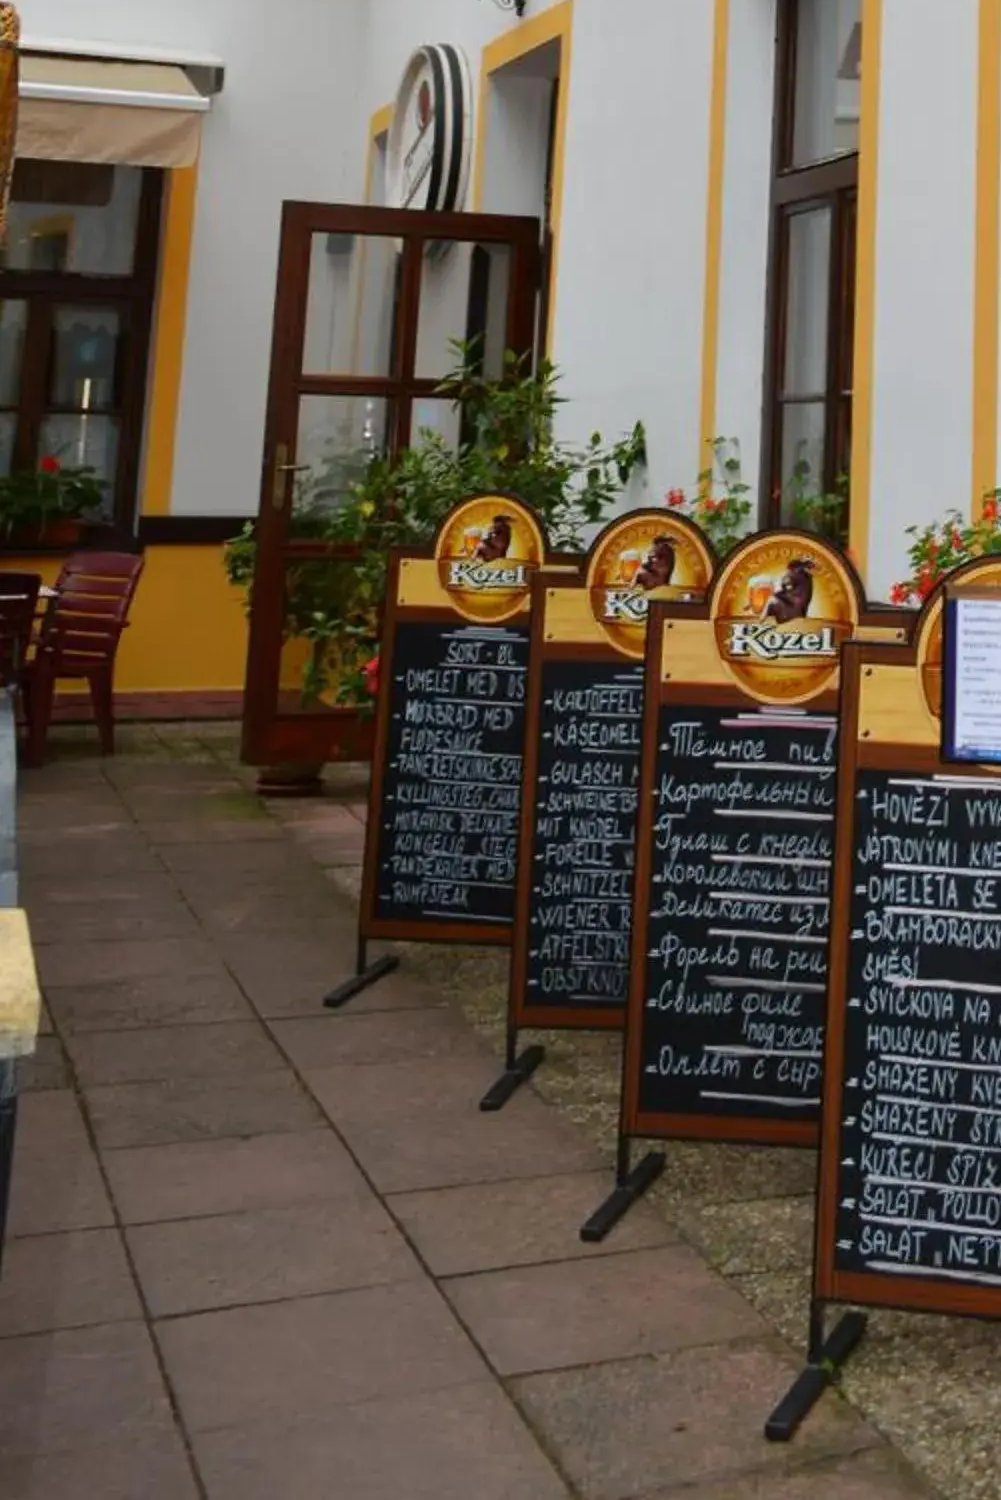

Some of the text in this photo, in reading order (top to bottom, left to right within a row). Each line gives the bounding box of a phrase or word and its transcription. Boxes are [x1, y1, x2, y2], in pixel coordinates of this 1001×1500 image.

[448, 559, 527, 590] Kozel
[730, 622, 838, 660] Kozel
[406, 669, 461, 694] OMELET
[483, 707, 514, 732] MED
[550, 760, 623, 785] GULASCH
[536, 817, 563, 838] MIT
[541, 872, 631, 898] SCHNITZEL
[867, 873, 960, 908] OMELETA
[972, 879, 998, 909] SE
[538, 904, 610, 929] WIENER
[750, 948, 780, 970] на
[963, 997, 991, 1025] NA
